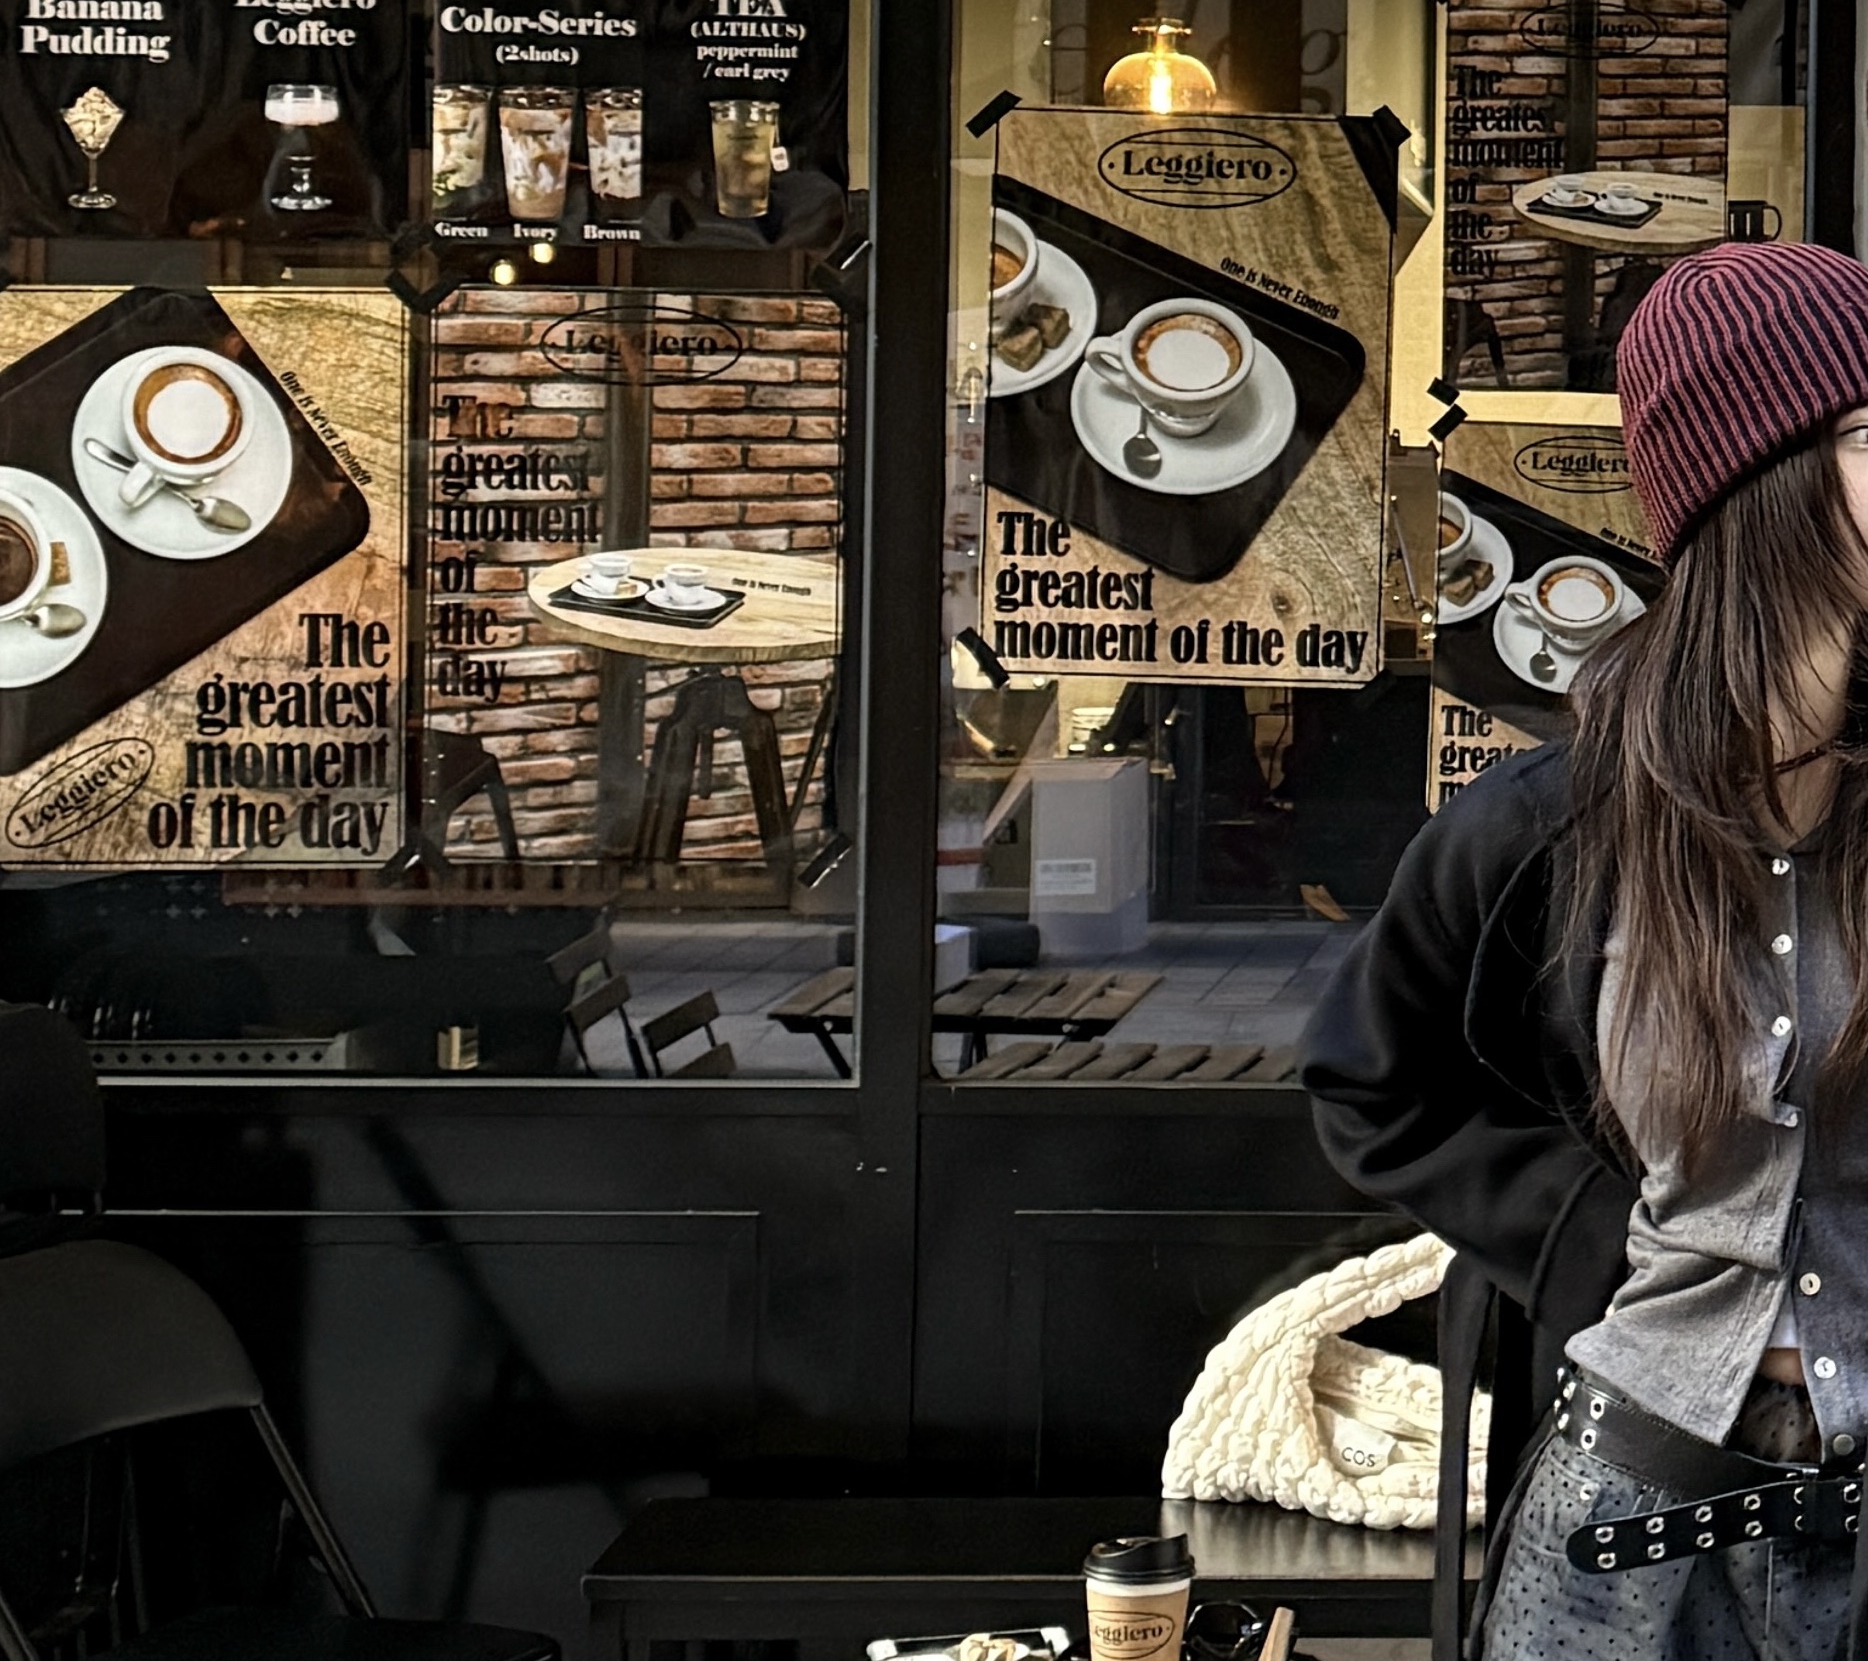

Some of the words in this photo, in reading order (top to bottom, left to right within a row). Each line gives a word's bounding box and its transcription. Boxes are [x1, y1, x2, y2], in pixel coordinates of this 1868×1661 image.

[253, 18, 356, 47] Coffee
[440, 6, 637, 37] Color-Series
[691, 21, 806, 41] (ALTHAUS)
[19, 25, 171, 63] Pudding
[496, 44, 579, 66] (2shots)
[697, 43, 798, 61] peppermint
[714, 62, 750, 78] earl
[752, 67, 790, 82] grey
[1122, 149, 1272, 185] Leggiero
[434, 221, 488, 238] Green
[513, 223, 557, 242] Ivory
[583, 225, 640, 240] Brown
[566, 329, 717, 362] Leiero
[441, 446, 590, 497] greatest
[440, 503, 599, 542] moment
[997, 511, 1071, 557] The
[440, 550, 481, 593] of
[995, 562, 1155, 612] greatest
[298, 613, 390, 668] The
[438, 603, 499, 646] the
[994, 618, 1158, 663] moment
[1170, 619, 1211, 664] of
[1221, 620, 1285, 666] the
[1296, 623, 1368, 674] day
[437, 654, 507, 704] day
[196, 672, 391, 736] greatest
[1441, 705, 1493, 737] The
[185, 733, 390, 788] moment
[19, 753, 136, 834] Leggiero
[148, 793, 197, 849] of
[210, 793, 287, 848] the
[300, 793, 390, 856] day
[1341, 1446, 1376, 1468] COS
[1095, 1625, 1163, 1646] eggiero
